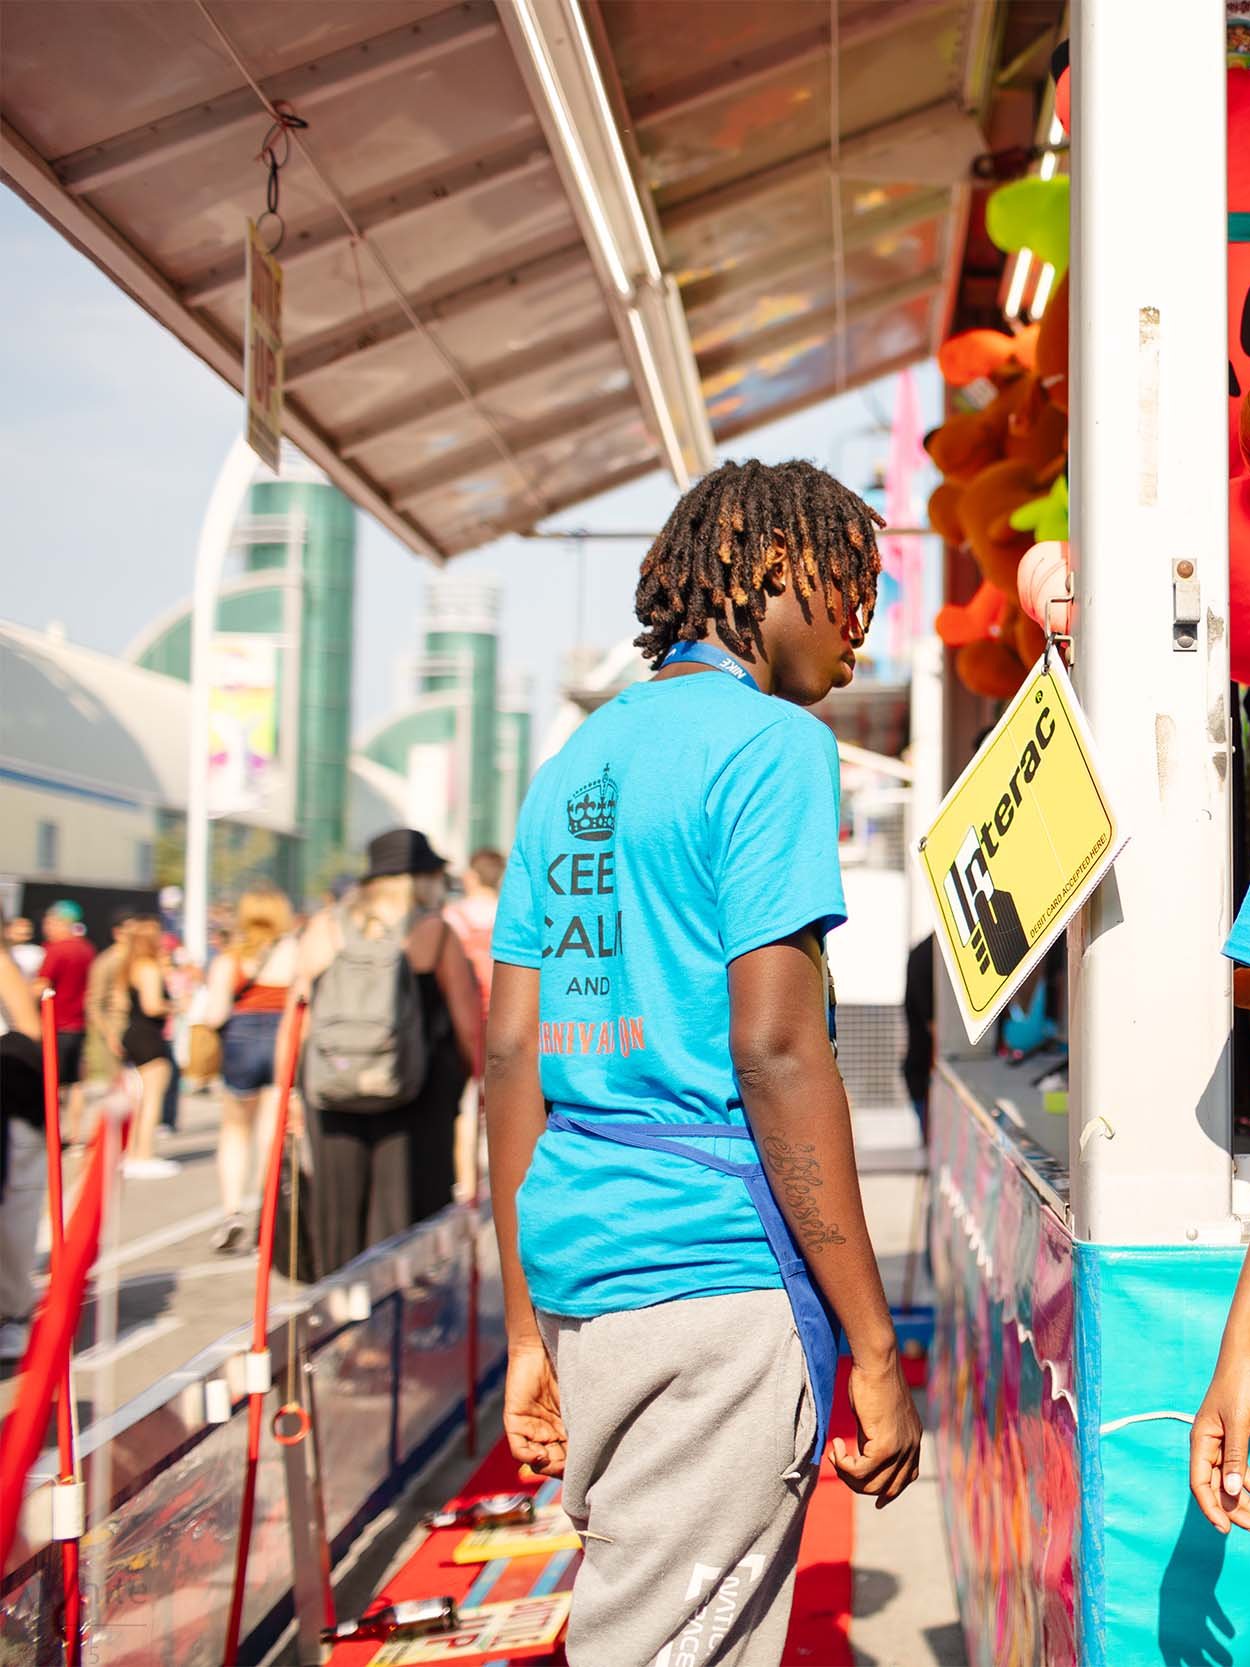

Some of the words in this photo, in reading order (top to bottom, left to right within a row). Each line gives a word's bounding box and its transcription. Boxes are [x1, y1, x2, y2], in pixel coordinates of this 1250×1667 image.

[719, 657, 747, 680] NIKE
[1029, 914, 1047, 938] DEBIT
[1047, 893, 1062, 917] CARD
[1062, 856, 1091, 897] ACCEPTED
[1089, 833, 1108, 859] HERE!
[566, 976, 610, 996] AND
